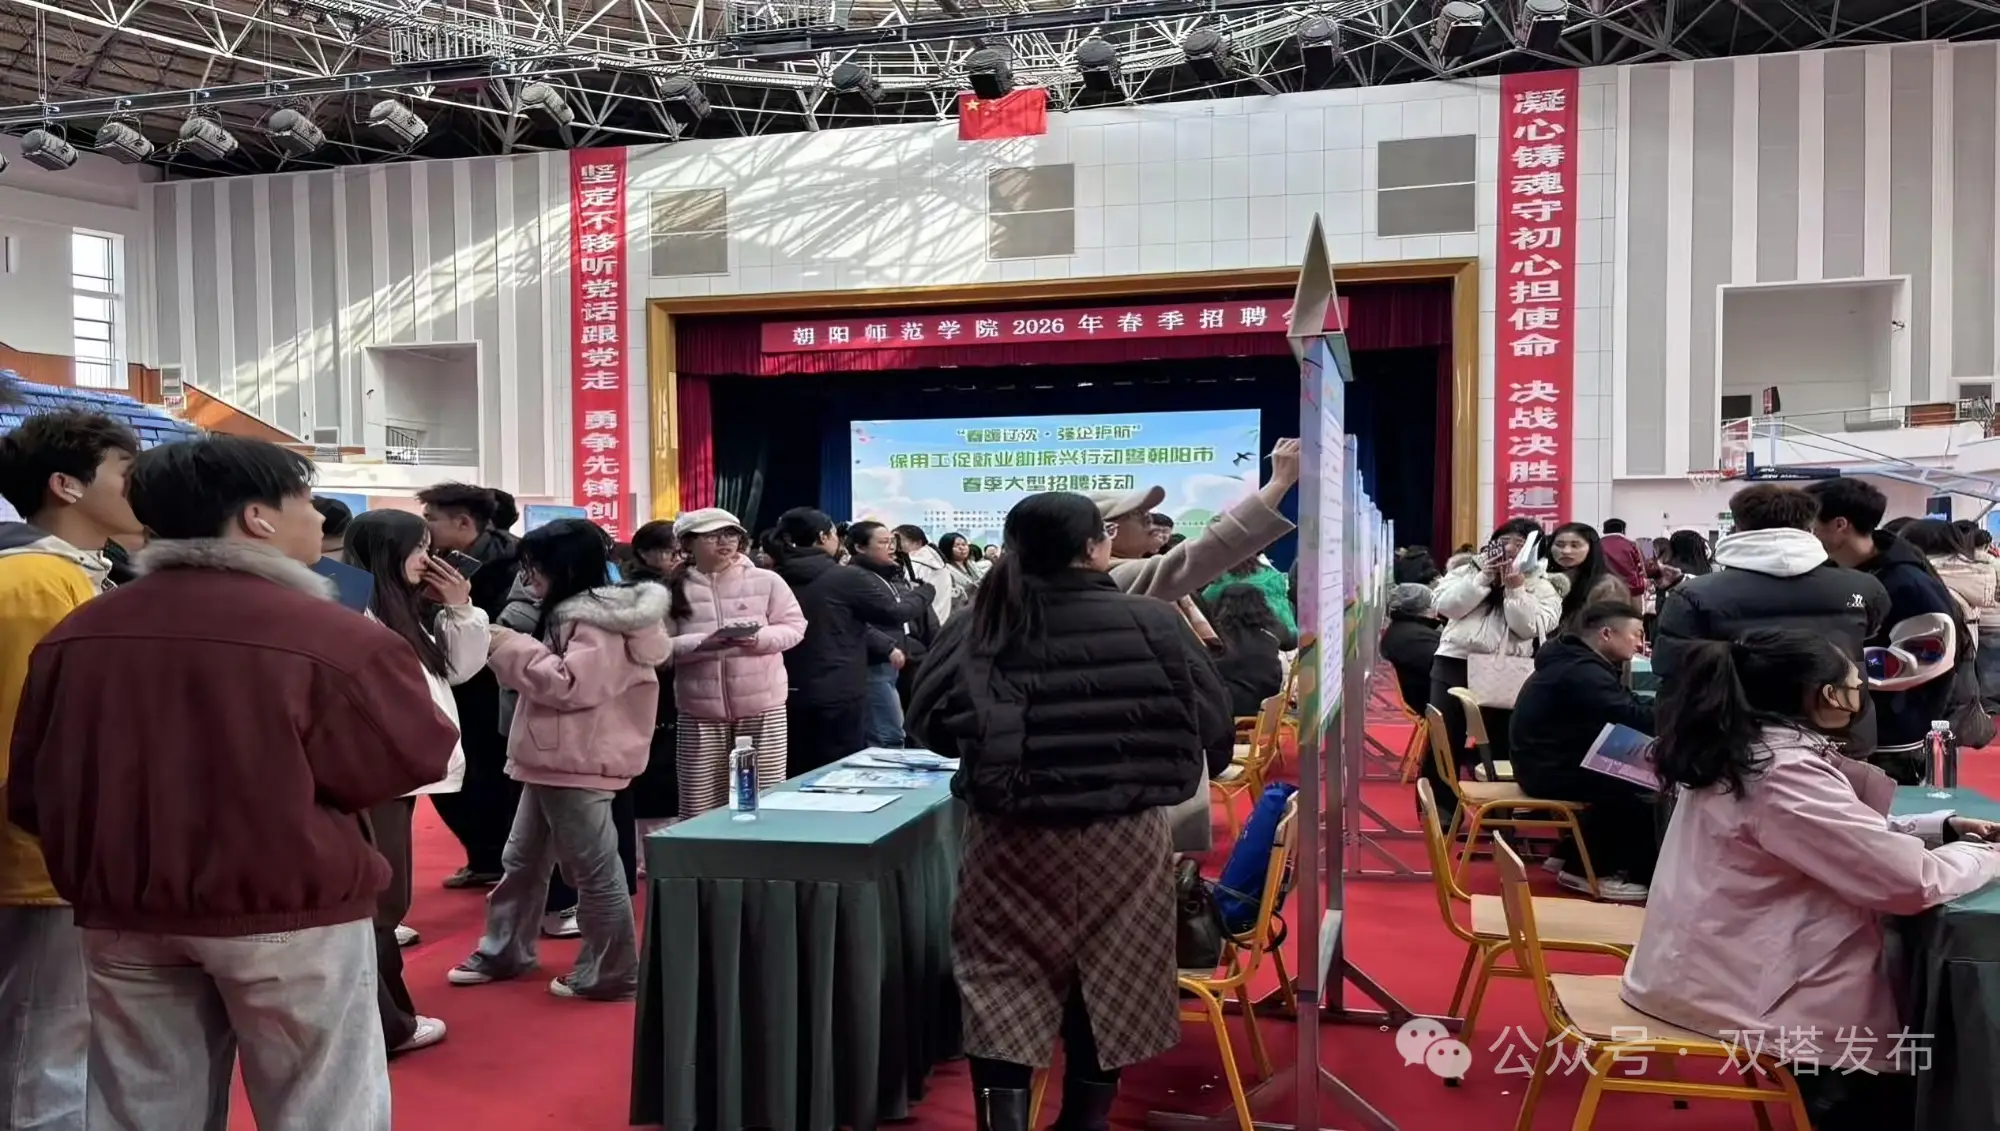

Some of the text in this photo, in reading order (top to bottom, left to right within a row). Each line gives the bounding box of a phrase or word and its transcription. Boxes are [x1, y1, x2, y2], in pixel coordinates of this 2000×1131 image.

[580, 163, 619, 390] 坚定不移听党话跟党走
[1509, 87, 1566, 358] 凝心铸魂守初心担使命
[793, 304, 1293, 346] 朝阳师范学院2026年春季招聘
[962, 474, 1134, 492] 春季大型招聘活动
